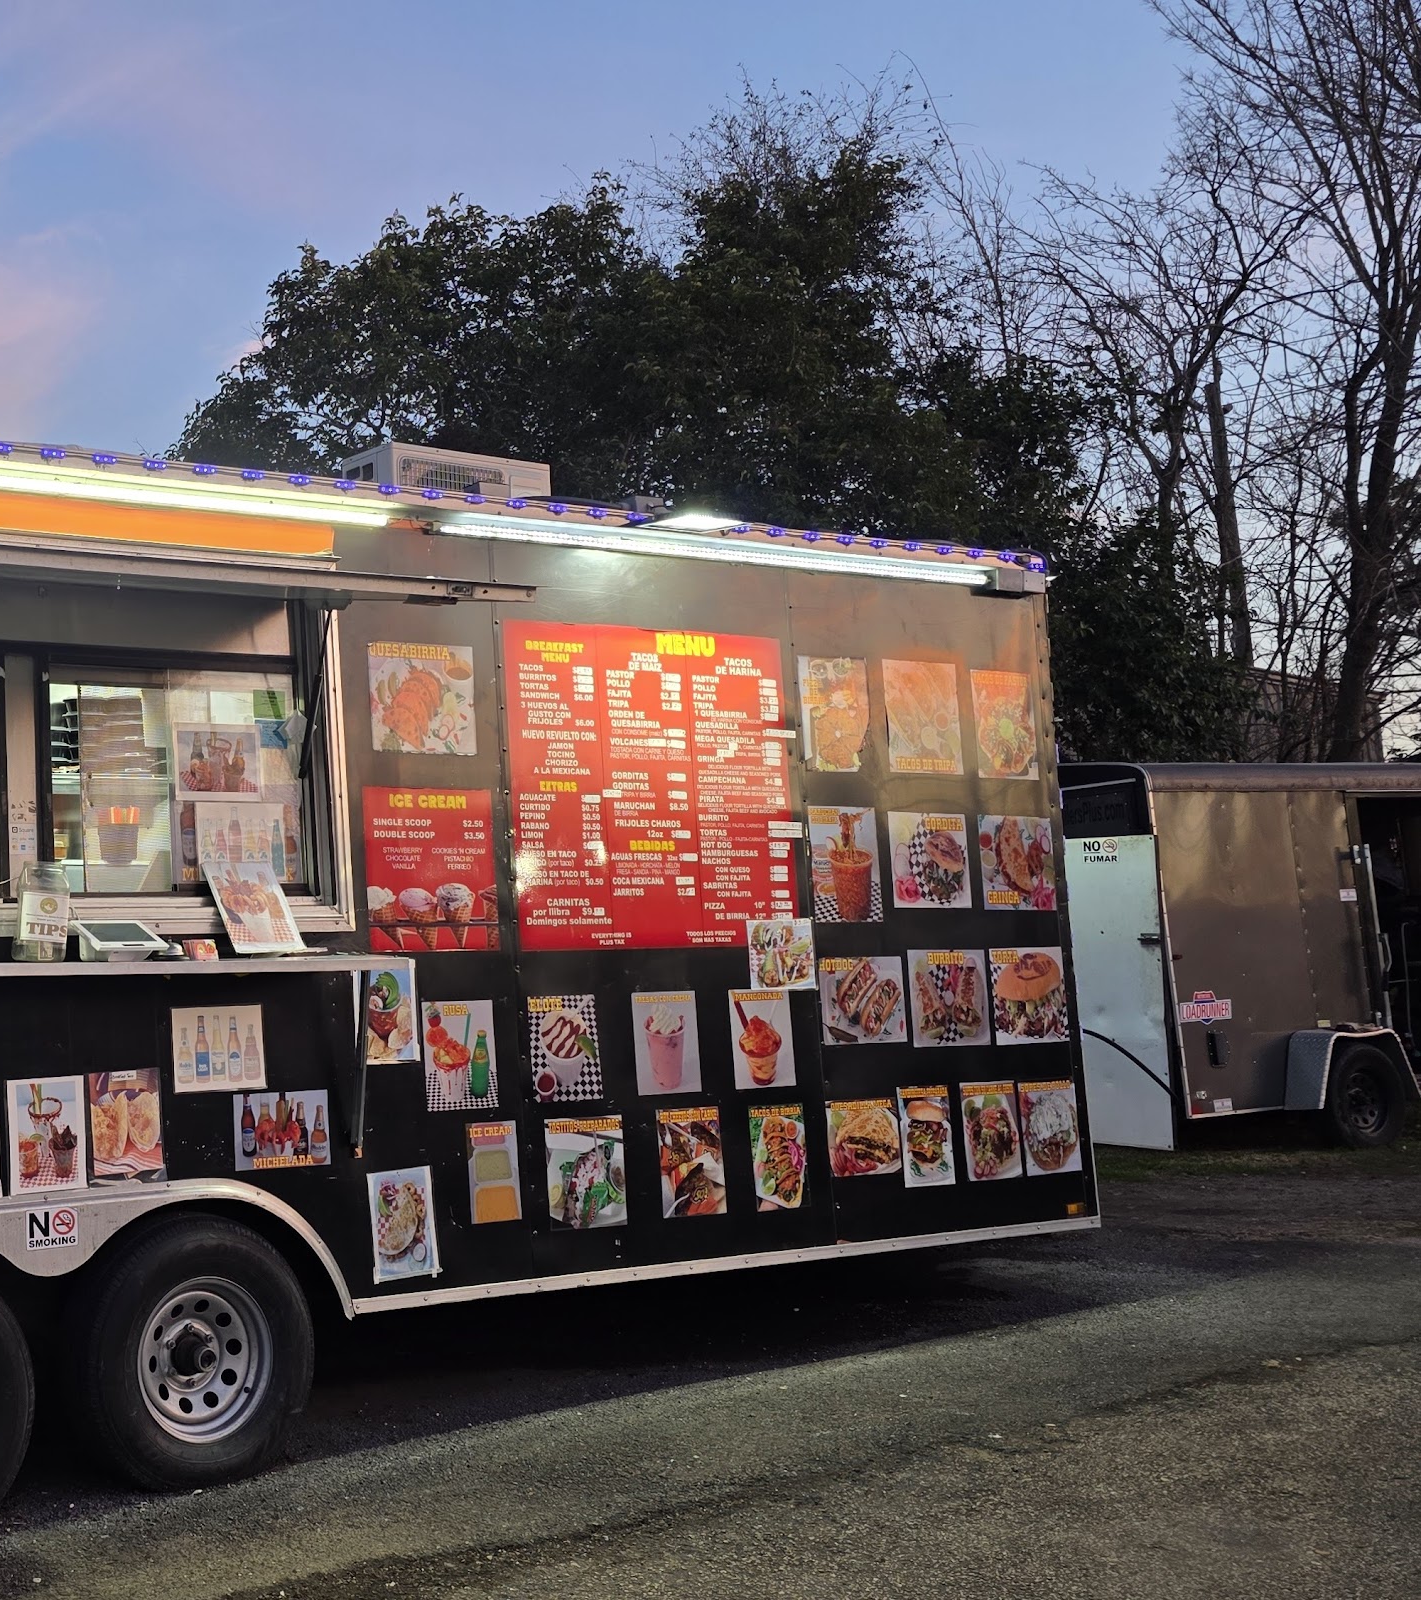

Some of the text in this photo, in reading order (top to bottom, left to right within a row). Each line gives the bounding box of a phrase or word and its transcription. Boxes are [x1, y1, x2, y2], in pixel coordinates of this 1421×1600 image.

[525, 640, 584, 653] BREAKFAST
[655, 633, 715, 657] MENU
[541, 652, 569, 663] MENU
[724, 657, 752, 667] TACOS
[519, 663, 543, 672] TACOS
[715, 666, 762, 677] DE HARINA
[519, 673, 557, 682] BURRITOS
[606, 670, 634, 679] PASTOR
[692, 675, 719, 683] PASTOR
[520, 682, 549, 690] TORTAS
[606, 679, 630, 687] POLLO
[693, 684, 716, 692] POLLO
[520, 692, 593, 702] SANDWICH $6.00
[607, 689, 632, 698] FAJITA
[693, 693, 717, 701] FAJITA
[608, 700, 629, 708] TRIPA
[693, 702, 714, 710] TRIPA
[528, 710, 553, 718] GUSTO
[528, 717, 594, 727] FRIJOLES $6.00
[611, 720, 660, 729] QUESABIRRIA
[695, 722, 738, 730] QUESADILLA
[522, 729, 597, 741] HUEVO REVUELTO CON:
[548, 742, 574, 750] JAMON
[547, 750, 575, 758] TOCINO
[896, 757, 957, 772] TACOS DE TRIPA
[612, 772, 648, 780] GORDITAS
[698, 776, 746, 784] CAMPECHANA
[540, 781, 577, 792] EXTRAS
[613, 782, 649, 790] GORDITAS
[389, 794, 466, 809] ICE CREAM
[519, 793, 556, 801] AGUACATE
[520, 803, 599, 812] CURTIDO $0.75
[614, 802, 655, 810] MARUCHAN
[669, 803, 688, 811] $8.50
[520, 812, 600, 821] PEPINO $0.50
[373, 818, 403, 826] SINGLE
[463, 820, 483, 828] $2.50
[615, 819, 681, 828] FRIJOLES CHAROS
[926, 817, 964, 831] GORDITA
[409, 831, 435, 839] SCOOP
[464, 832, 484, 840] $3.50
[521, 831, 600, 840] LIMON $1.00
[522, 841, 544, 849] SALSA
[630, 840, 675, 851] BEBIDAS
[1083, 841, 1101, 852] NO
[611, 853, 662, 861] AGUAS FRESCAS
[613, 877, 664, 885] COCA MEXICANA
[613, 888, 644, 896] JARRITOS
[547, 898, 590, 906] CARNITAS
[987, 891, 1021, 905] GRINGA
[527, 917, 612, 926] Domingos solamente
[26, 922, 67, 937] TIPS
[927, 952, 965, 964] BURRITO
[991, 951, 1020, 963] TORTA
[530, 998, 562, 1012] ELOTE
[443, 1004, 469, 1016] RUSA
[1182, 1003, 1229, 1019] LOADRUNNER
[469, 1125, 512, 1138] ICE CREAM
[253, 1155, 314, 1168] MICHELADA
[29, 1236, 75, 1248] SMOKING
